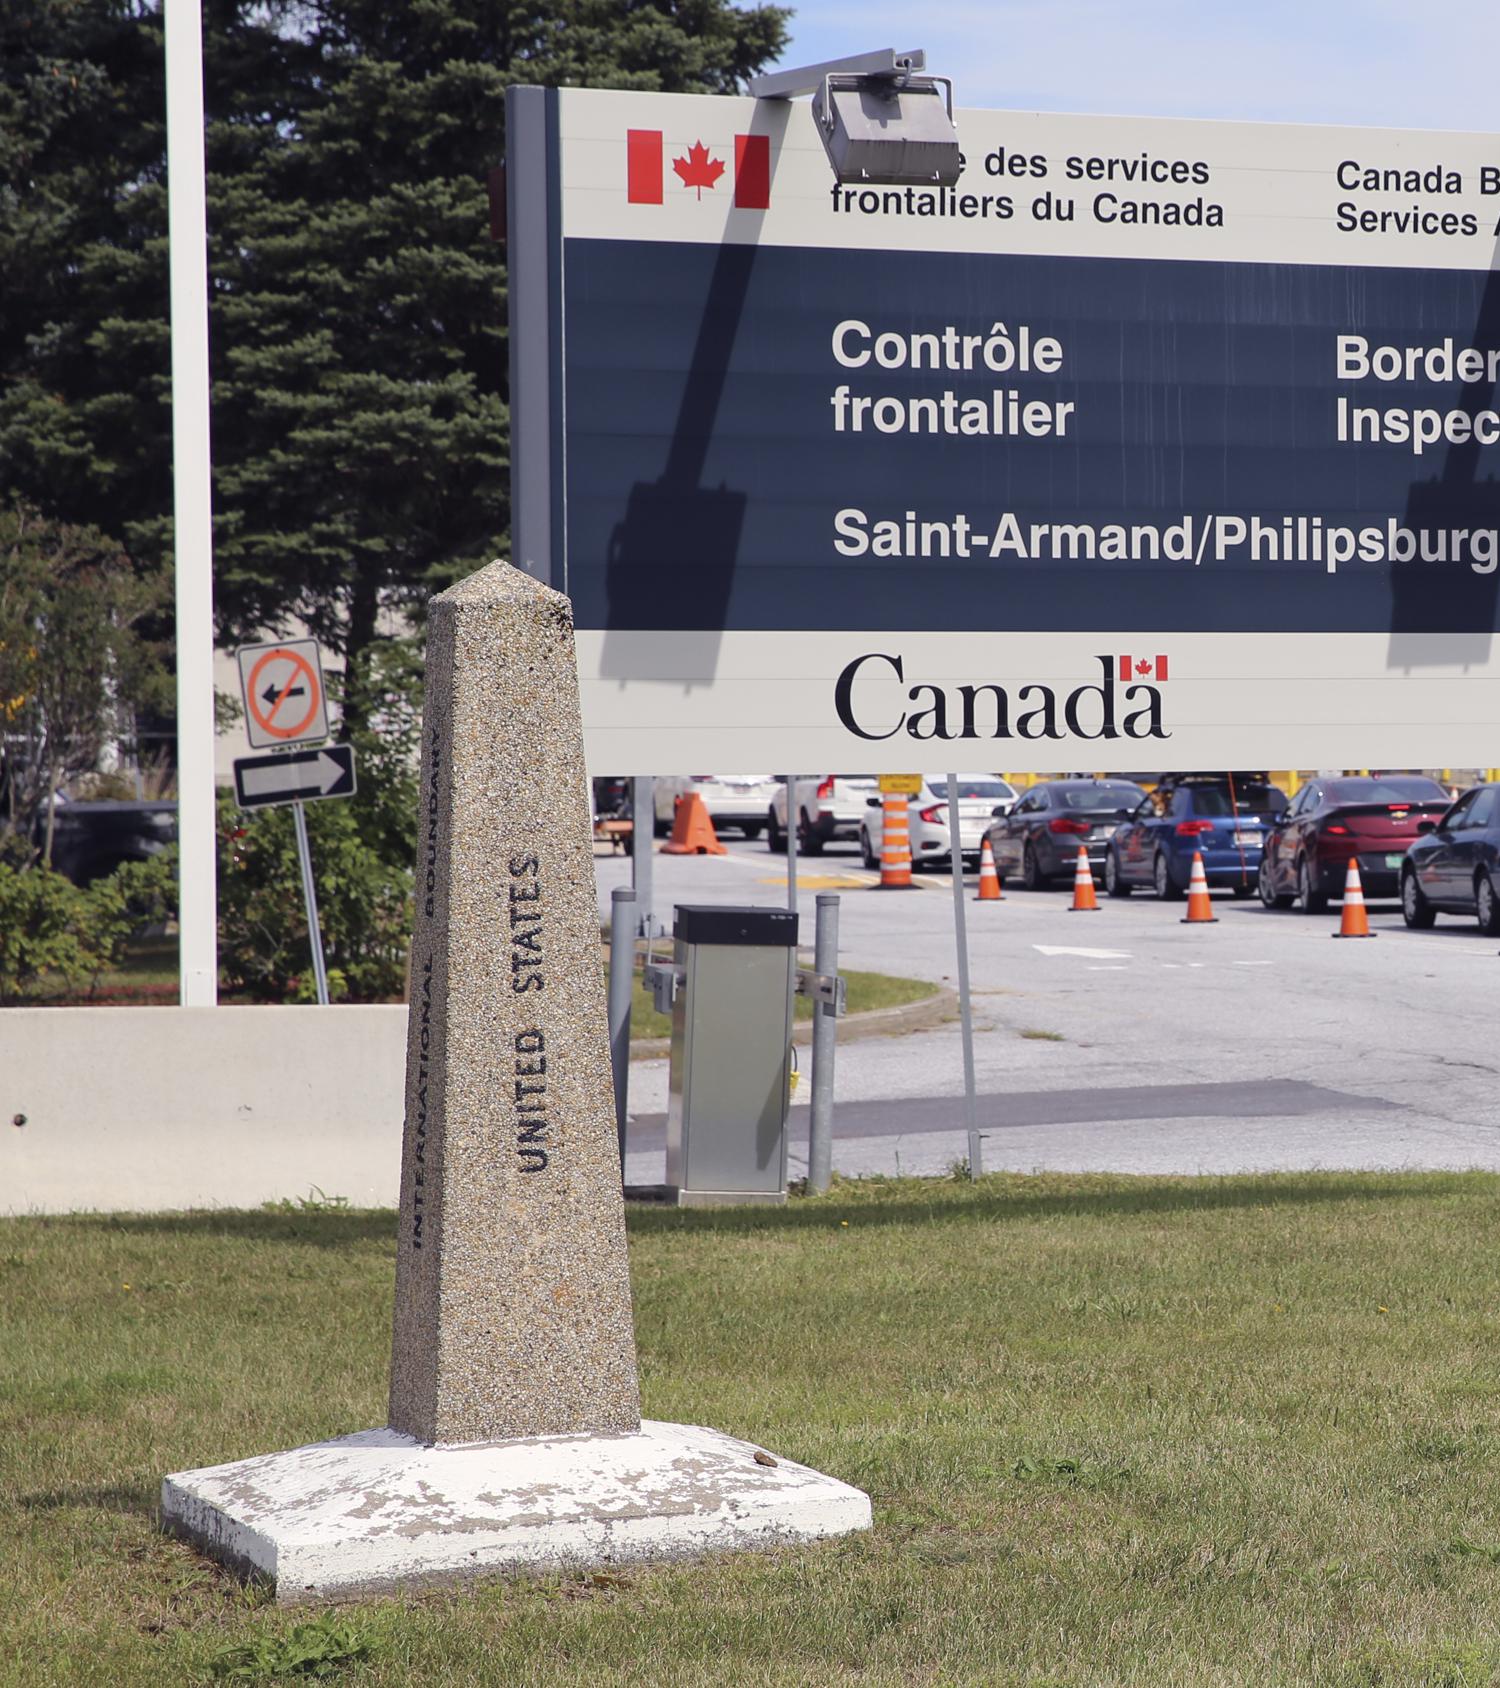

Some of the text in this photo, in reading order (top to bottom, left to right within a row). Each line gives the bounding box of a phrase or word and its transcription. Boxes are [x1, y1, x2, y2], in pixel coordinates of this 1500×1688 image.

[984, 147, 1048, 178] des
[1065, 152, 1211, 185] services
[1336, 160, 1463, 195] Canada
[831, 184, 1225, 228] frontaliers du Canada
[1336, 201, 1479, 236] Services
[831, 319, 1064, 374] Contrôle
[830, 385, 1075, 436] frontalier
[833, 508, 1500, 574] Saint-Armand/Philipsburg
[834, 652, 1173, 741] Canada
[413, 726, 440, 1250] INTERNATIONAL BOUNDARY
[509, 853, 549, 1174] UNITED STATES
